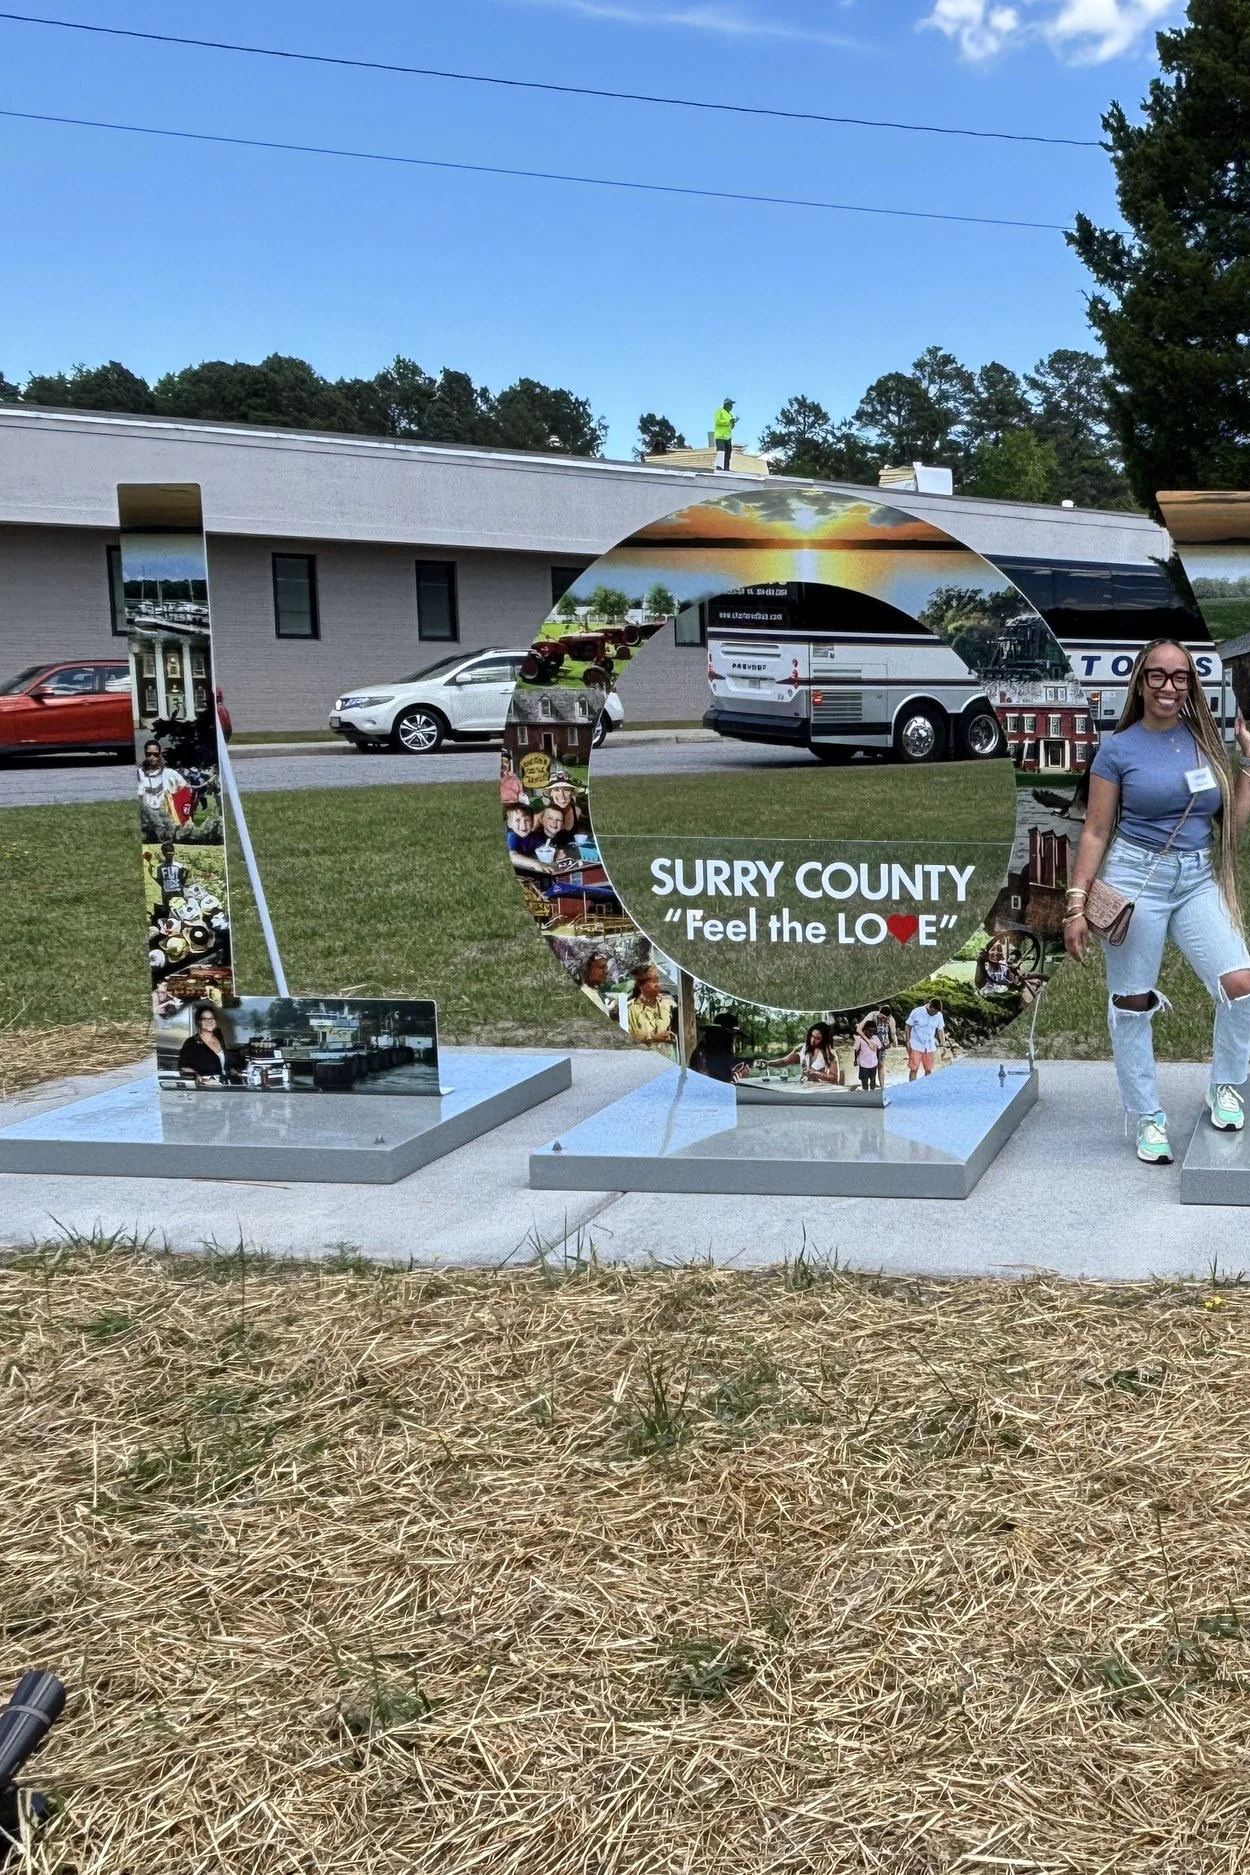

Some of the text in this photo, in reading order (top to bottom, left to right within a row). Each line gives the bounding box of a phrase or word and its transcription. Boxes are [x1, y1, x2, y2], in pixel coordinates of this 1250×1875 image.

[650, 857, 976, 902] SURRY COUNTY
[663, 906, 958, 946] "Feel the LOE"
